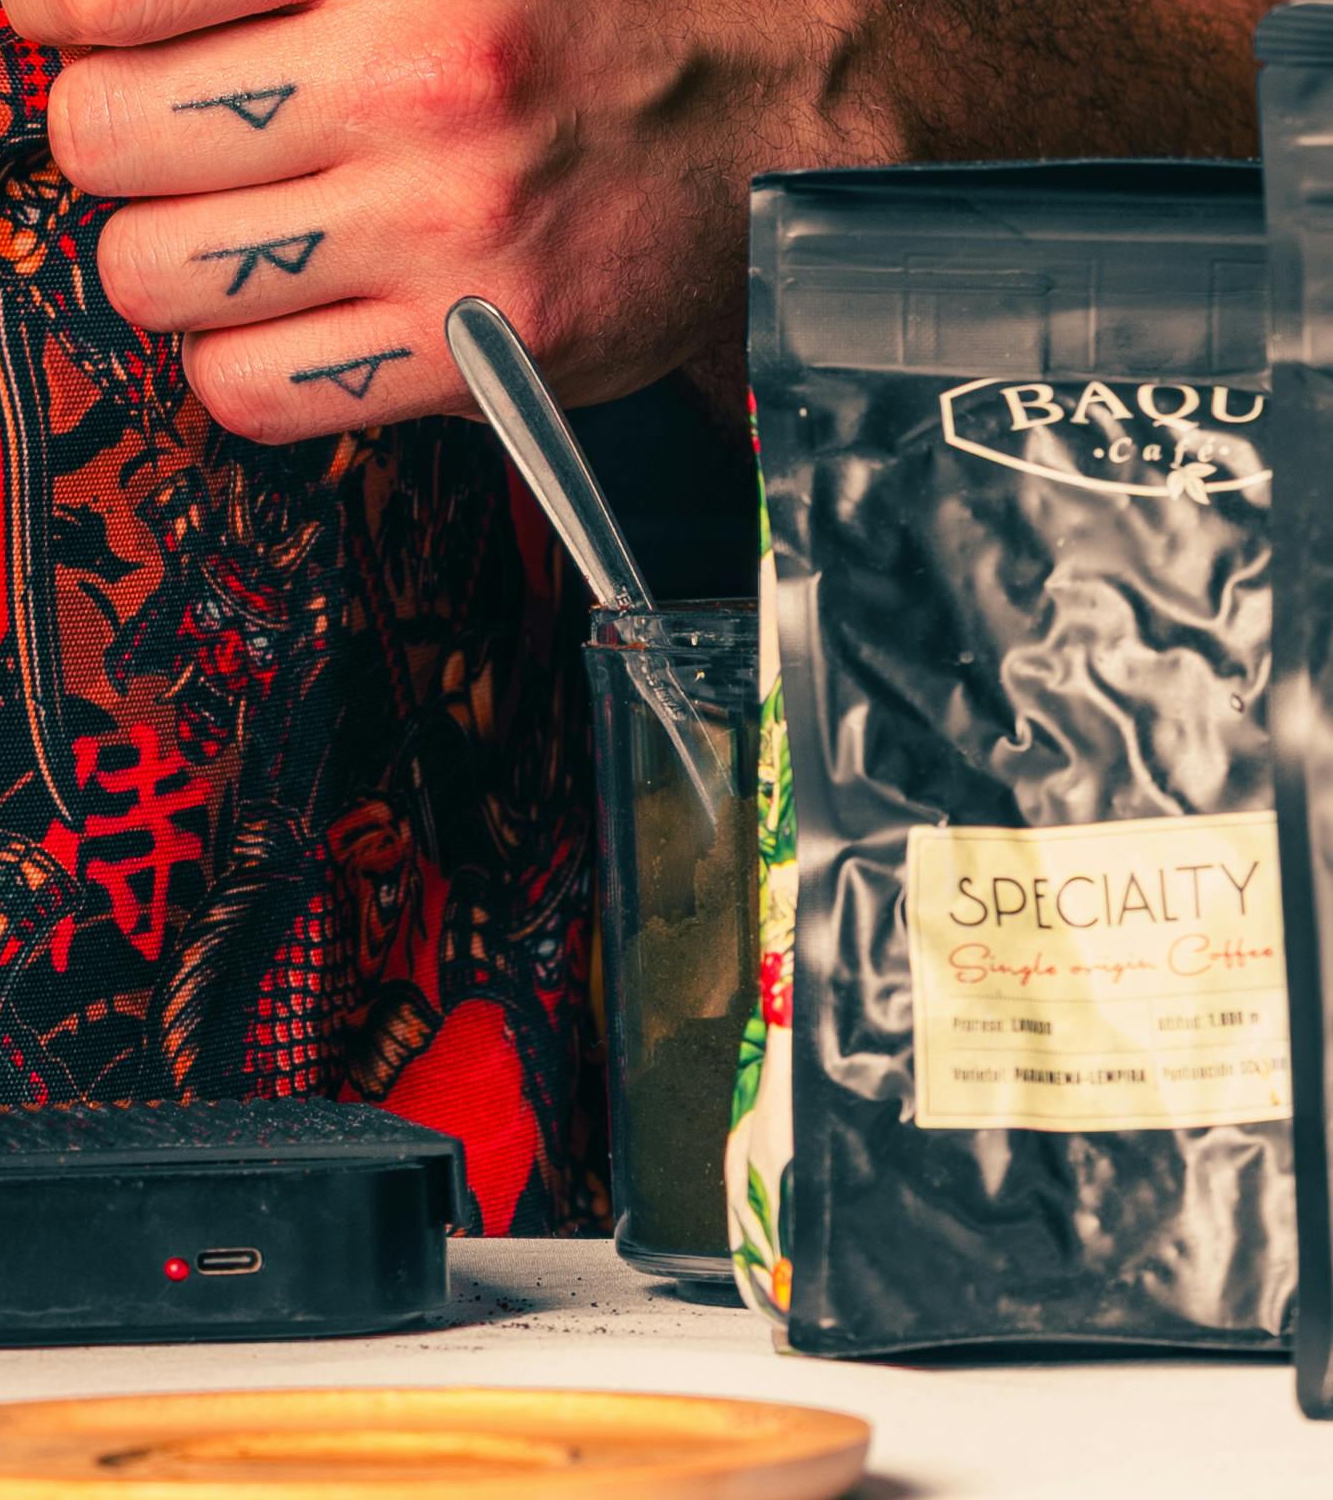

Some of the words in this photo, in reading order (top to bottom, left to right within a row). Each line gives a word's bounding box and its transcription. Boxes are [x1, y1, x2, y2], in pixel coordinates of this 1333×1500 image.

[948, 860, 1260, 930] SPECIALTY
[948, 942, 1058, 986] Single
[1069, 954, 1157, 984] origin
[1167, 934, 1275, 978] Coffee
